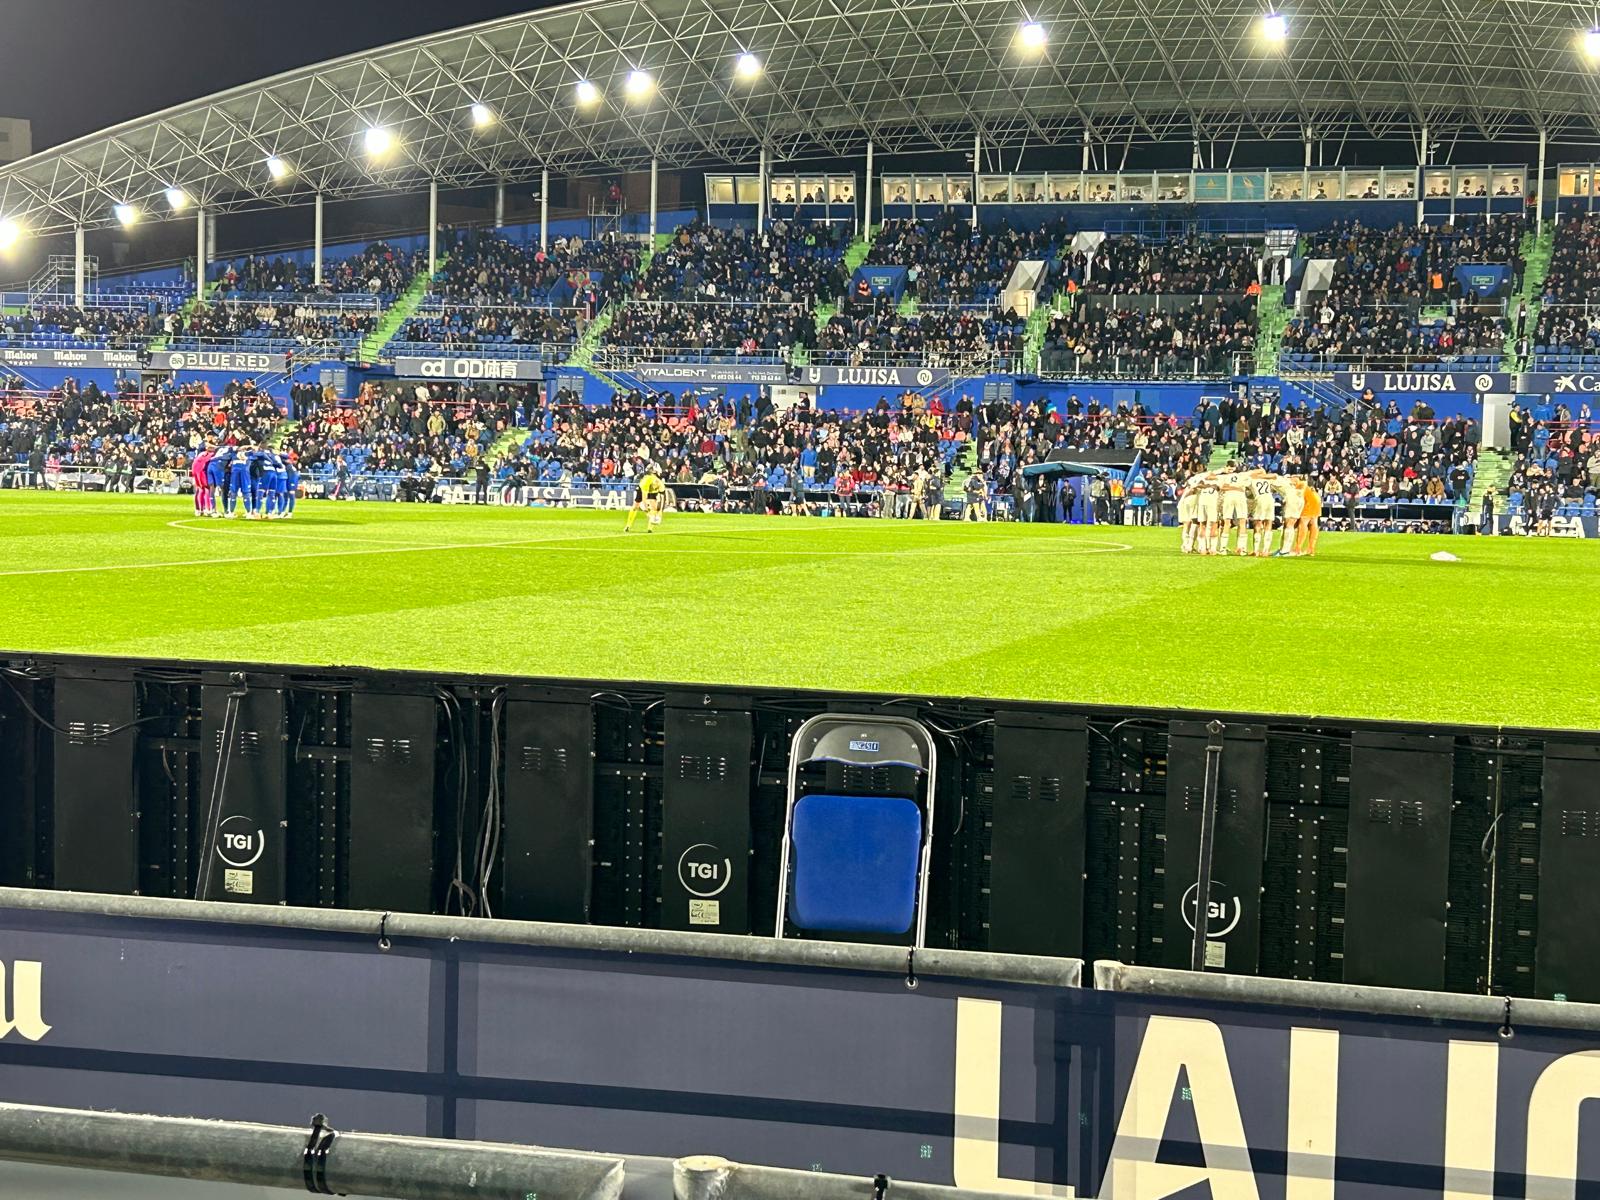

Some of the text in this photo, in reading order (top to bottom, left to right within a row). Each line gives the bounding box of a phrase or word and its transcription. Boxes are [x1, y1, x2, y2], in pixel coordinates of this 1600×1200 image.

[5, 350, 38, 360] Mahou
[54, 351, 87, 361] Mahou
[103, 352, 137, 361] Mahou
[186, 353, 270, 367] BLUE RED
[640, 368, 707, 377] VITALDENT
[837, 369, 901, 385] LUJISA
[1383, 374, 1457, 391] LUJISA
[1256, 481, 1269, 495] 22
[224, 833, 252, 850] TGI
[687, 862, 718, 879] TGI
[1192, 900, 1226, 919] GI
